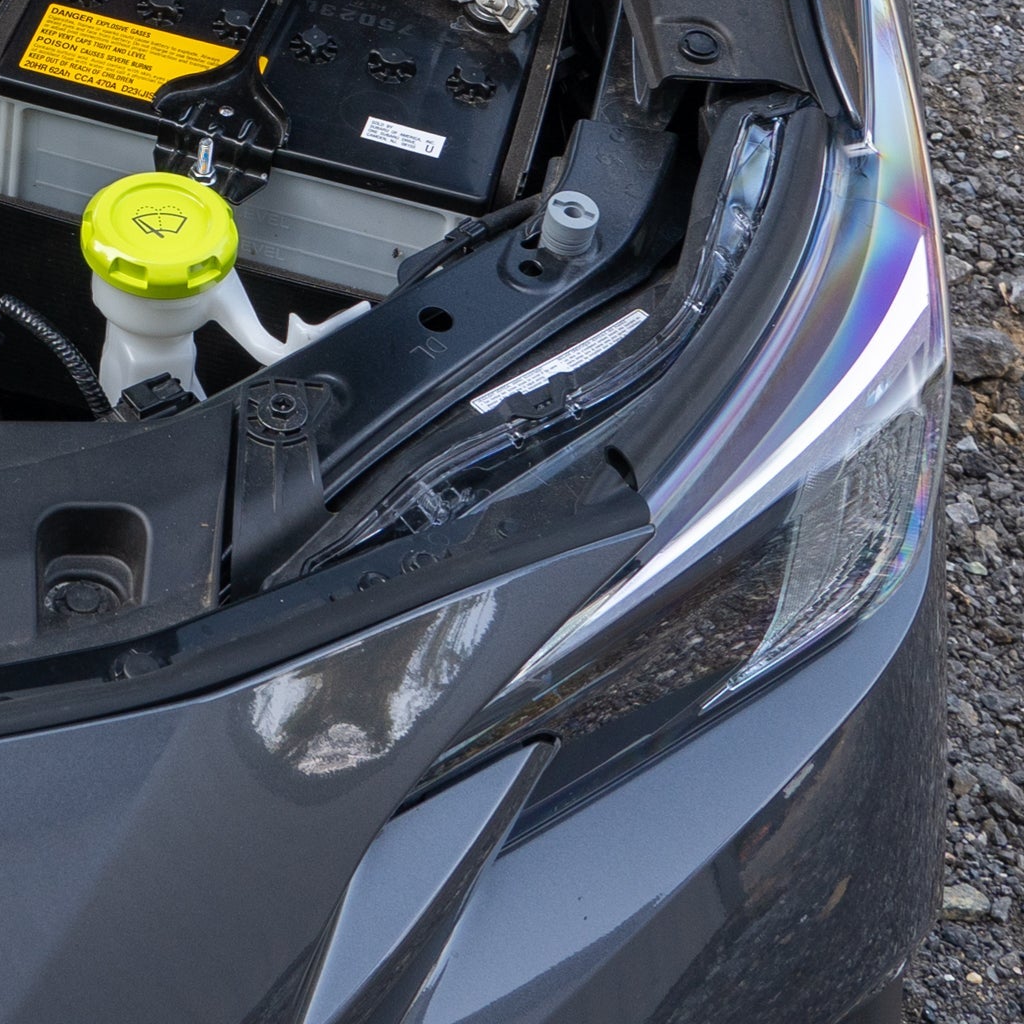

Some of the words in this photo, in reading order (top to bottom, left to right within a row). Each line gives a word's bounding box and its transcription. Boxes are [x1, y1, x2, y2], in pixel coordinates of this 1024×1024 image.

[50, 7, 93, 22] DANGER
[95, 19, 128, 32] EXPLOSIVE
[129, 28, 152, 38] GASES
[36, 35, 78, 51] POISON
[79, 47, 105, 58] CAUSES
[106, 54, 130, 65] SEVERE
[130, 61, 152, 71] BURNS
[40, 28, 57, 36] KEEP
[57, 32, 74, 40] VENT
[74, 37, 92, 45] CAPS
[93, 41, 111, 50] TIGHT
[112, 46, 126, 54] AND
[127, 50, 146, 59] LEVEL
[24, 59, 47, 71] 20HR
[48, 66, 71, 77] 62Ah
[73, 72, 95, 83] CCA
[95, 78, 118, 89] 470A
[28, 52, 45, 60] KEEP
[44, 56, 58, 64] OUT
[69, 62, 91, 72] REACH
[101, 71, 134, 83] CHILDREN
[425, 144, 435, 154] U
[240, 240, 285, 261] EVEL
